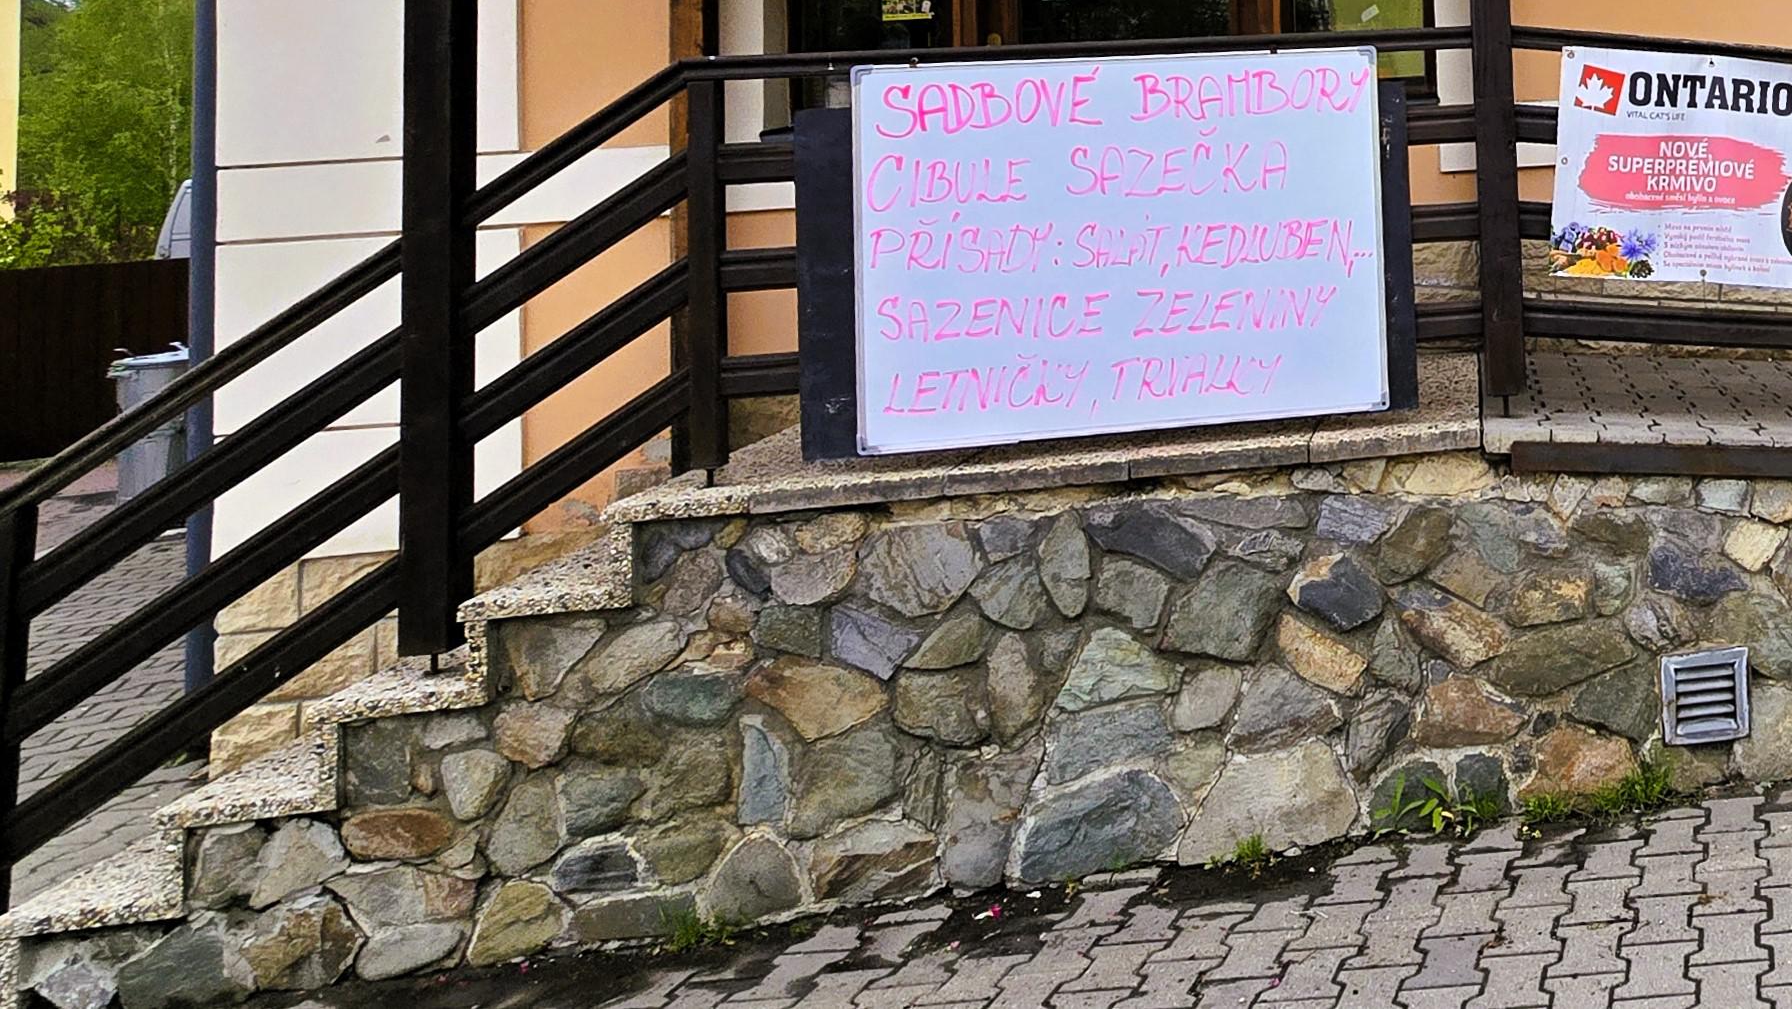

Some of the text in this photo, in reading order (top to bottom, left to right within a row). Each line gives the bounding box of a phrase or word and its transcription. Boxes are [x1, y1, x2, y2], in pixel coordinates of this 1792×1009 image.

[876, 66, 1370, 138] SADBOVÉ BRAMBORY
[1626, 110, 1649, 120] VITAL
[1671, 112, 1686, 121] LIFE
[1659, 138, 1713, 161] NOVÉ,
[867, 126, 1290, 214] CIBULE SAZEČKA
[1608, 154, 1755, 180] SUPERPRÉMIOVÉ
[1647, 175, 1717, 192] KRMIVO
[876, 286, 1338, 343] SAZENICE ZELENINY
